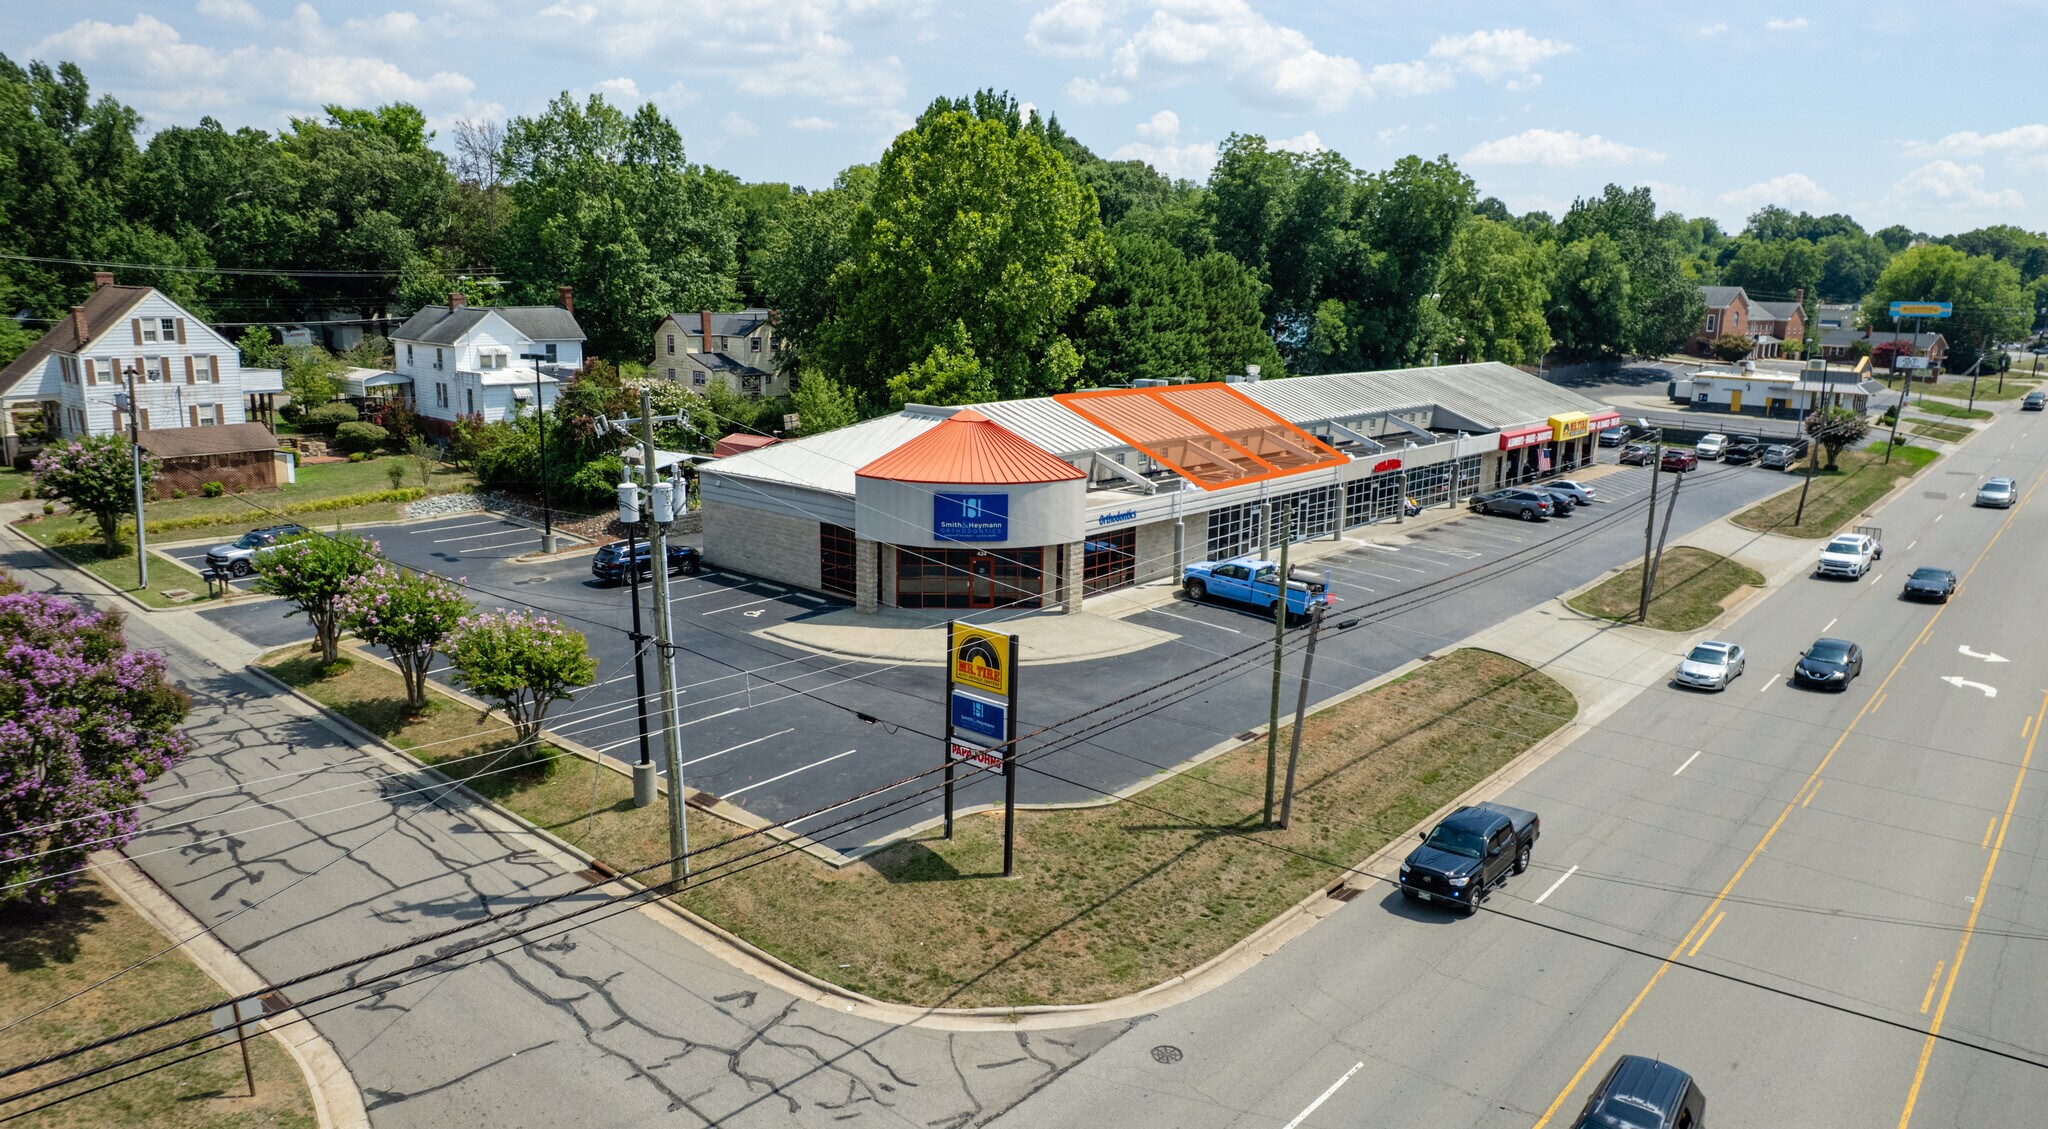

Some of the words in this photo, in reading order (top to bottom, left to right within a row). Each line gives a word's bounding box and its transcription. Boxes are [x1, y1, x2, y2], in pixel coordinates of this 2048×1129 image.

[1099, 509, 1136, 525] Orthodontics
[941, 521, 1002, 530] Smith&Heymann
[958, 660, 976, 675] MR.
[977, 665, 1000, 682] TIRE
